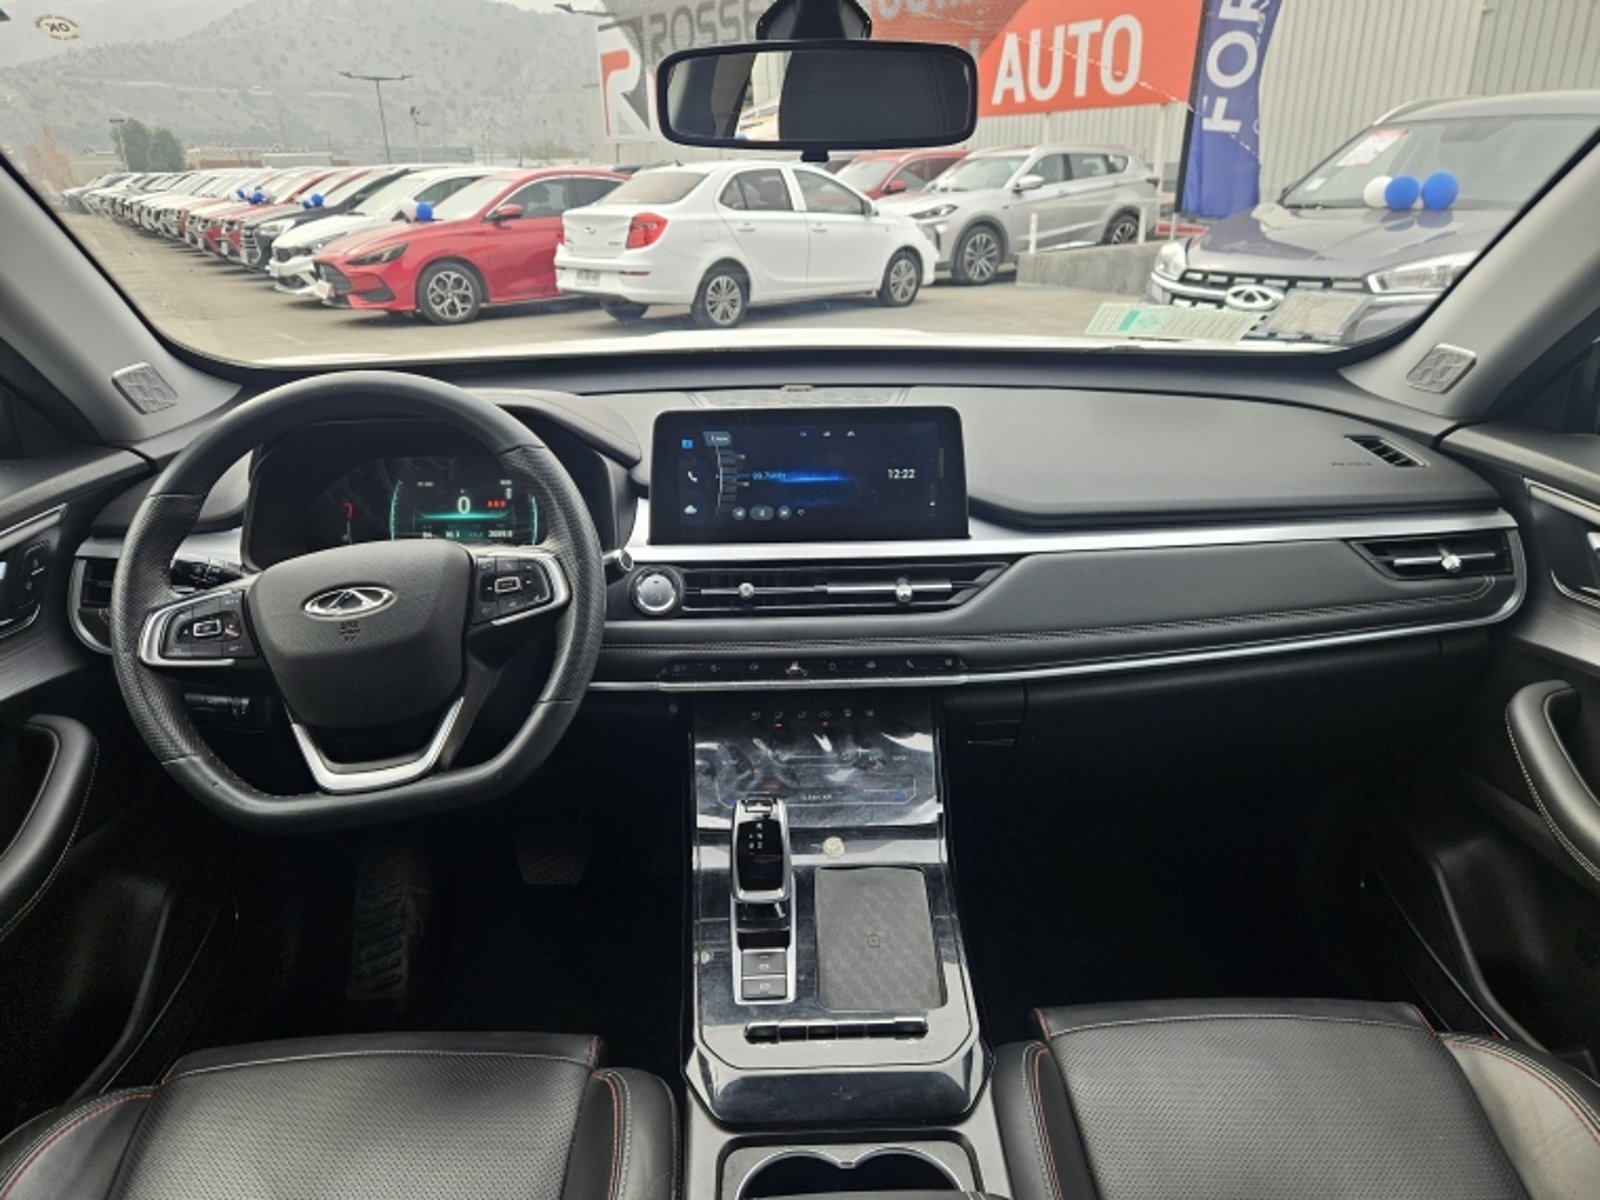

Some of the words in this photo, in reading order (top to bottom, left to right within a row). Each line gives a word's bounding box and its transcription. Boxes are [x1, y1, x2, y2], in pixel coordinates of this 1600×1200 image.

[991, 14, 1143, 105] AUTO
[887, 468, 916, 479] 12:22
[457, 495, 471, 514] 0
